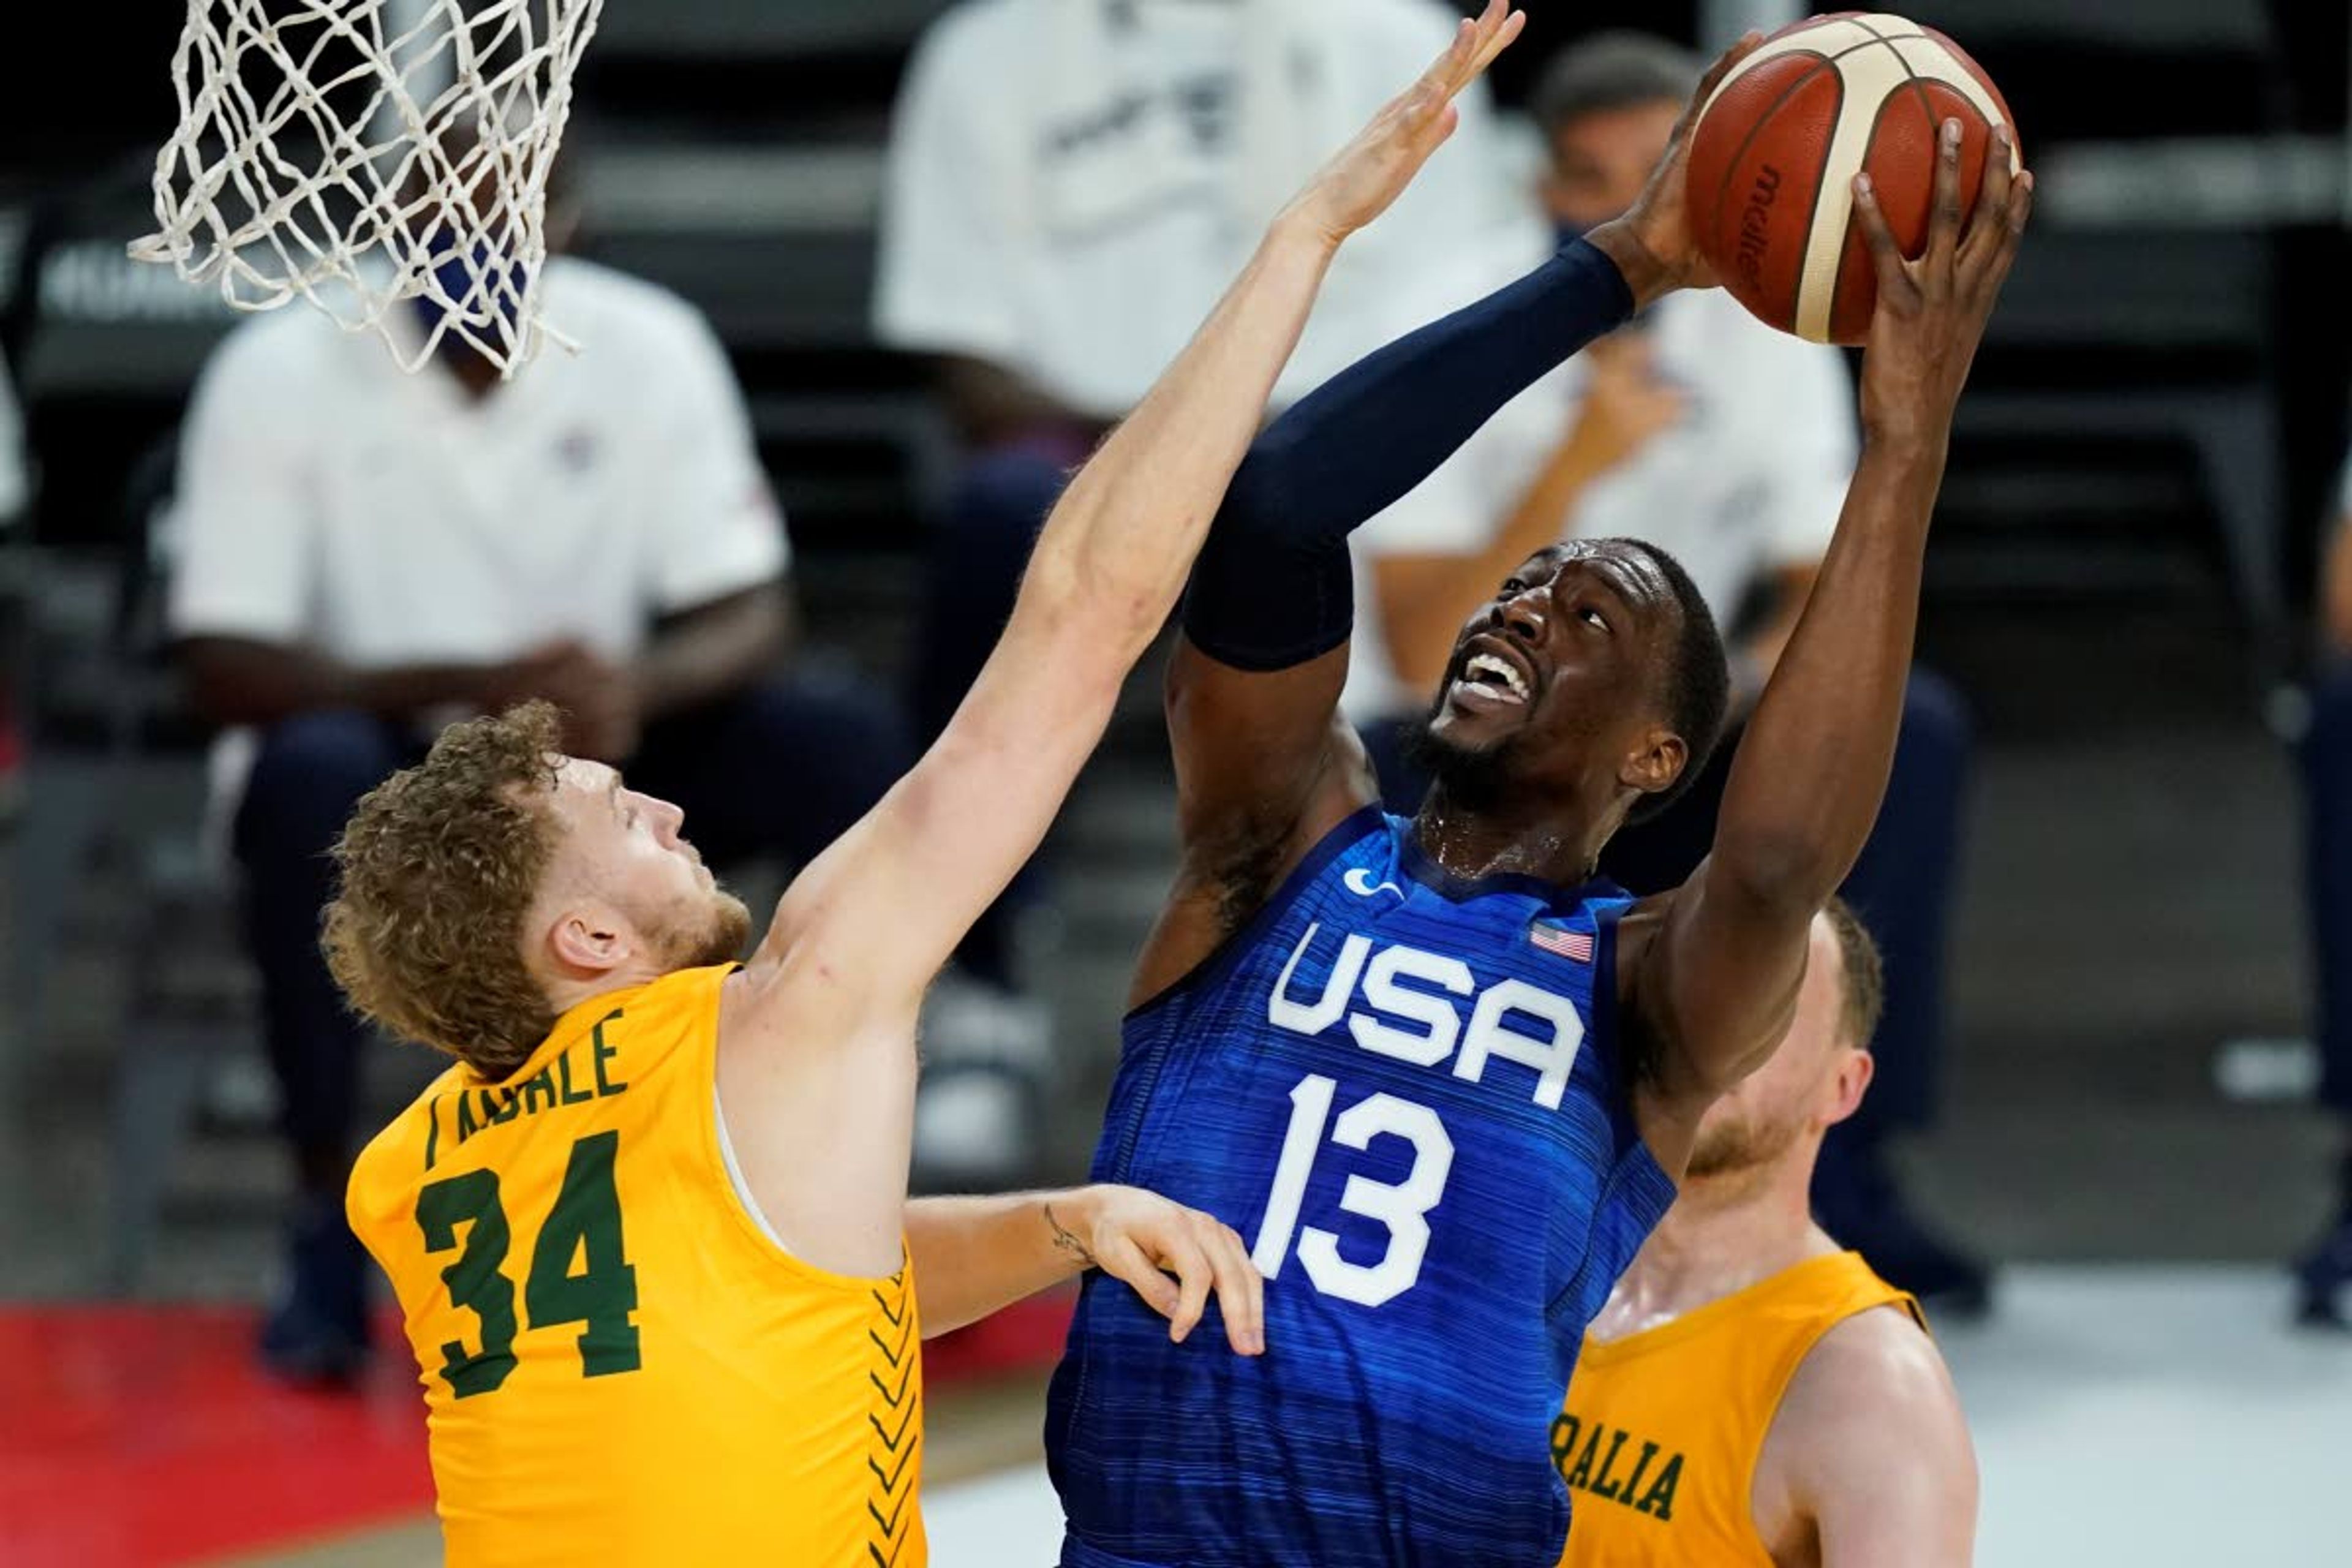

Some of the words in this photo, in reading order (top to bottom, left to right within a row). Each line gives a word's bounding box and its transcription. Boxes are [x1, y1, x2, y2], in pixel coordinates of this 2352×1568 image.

[1268, 922, 1585, 1110] USA
[415, 1129, 641, 1399] 34
[1251, 1073, 1455, 1307] 13
